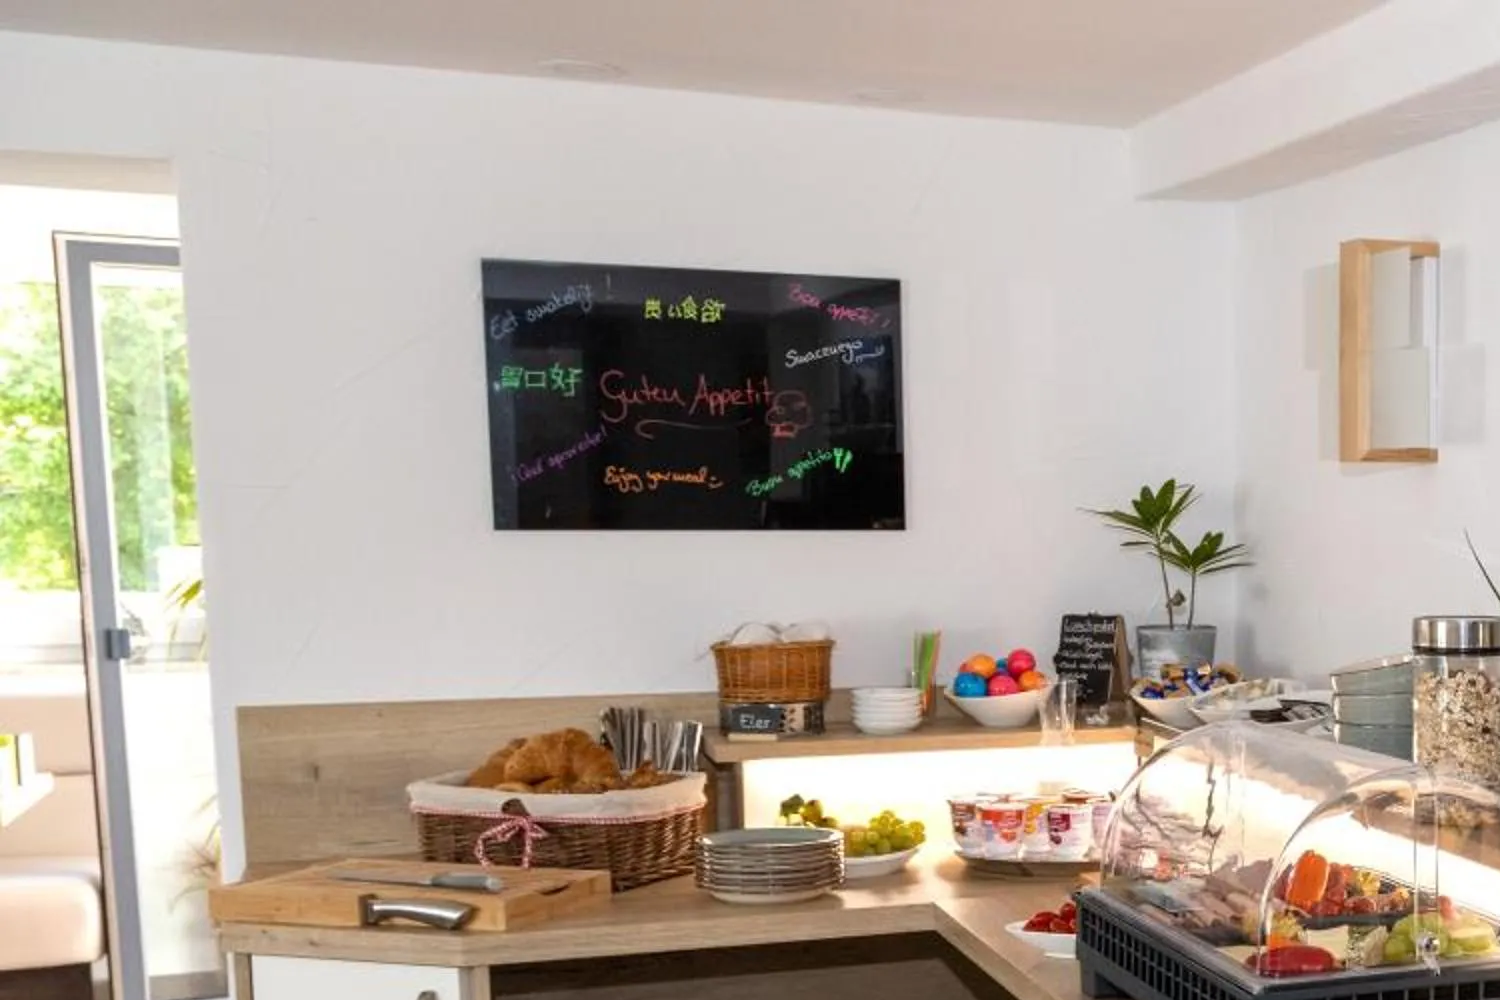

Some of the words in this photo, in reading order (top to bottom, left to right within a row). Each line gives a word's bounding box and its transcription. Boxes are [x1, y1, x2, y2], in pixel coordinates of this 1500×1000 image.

[600, 369, 686, 423] Guten
[688, 374, 774, 416] Appetit
[604, 465, 643, 493] Enjoy
[740, 713, 770, 729] Eier
